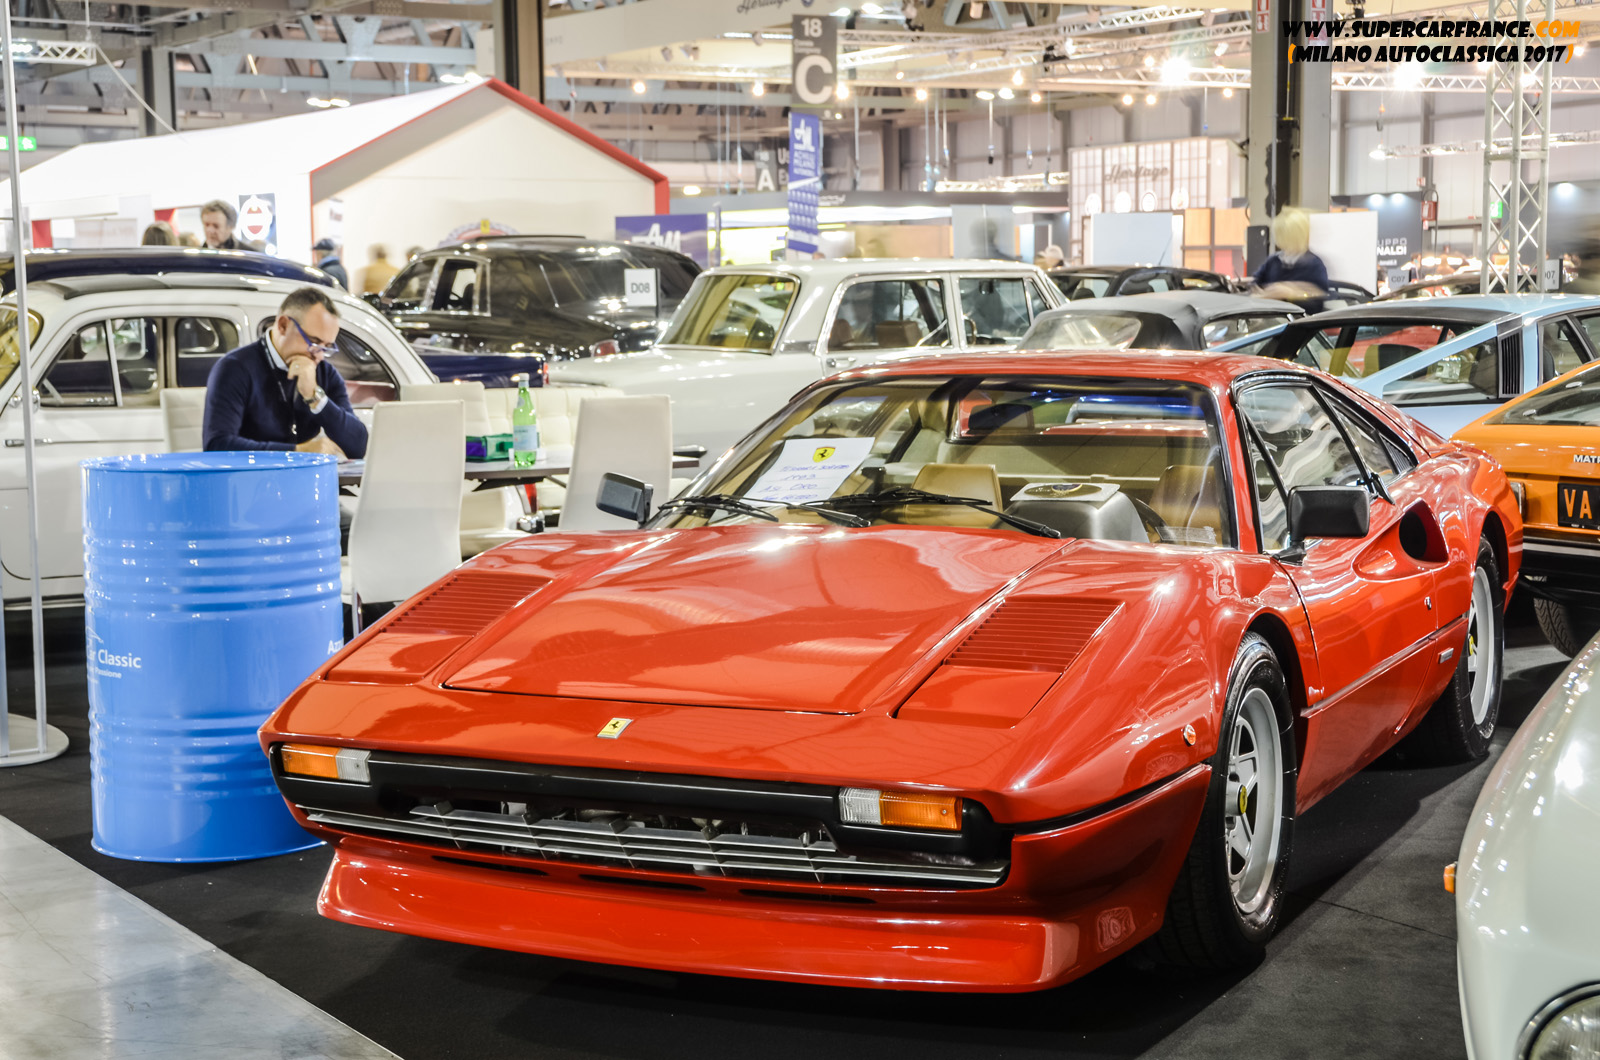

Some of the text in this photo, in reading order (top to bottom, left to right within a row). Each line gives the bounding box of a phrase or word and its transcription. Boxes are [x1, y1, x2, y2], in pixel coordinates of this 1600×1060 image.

[801, 18, 822, 37] 18
[795, 54, 833, 104] C
[757, 169, 775, 191] A
[631, 282, 650, 293] D08
[1564, 488, 1592, 519] VA
[97, 649, 142, 669] Classic
